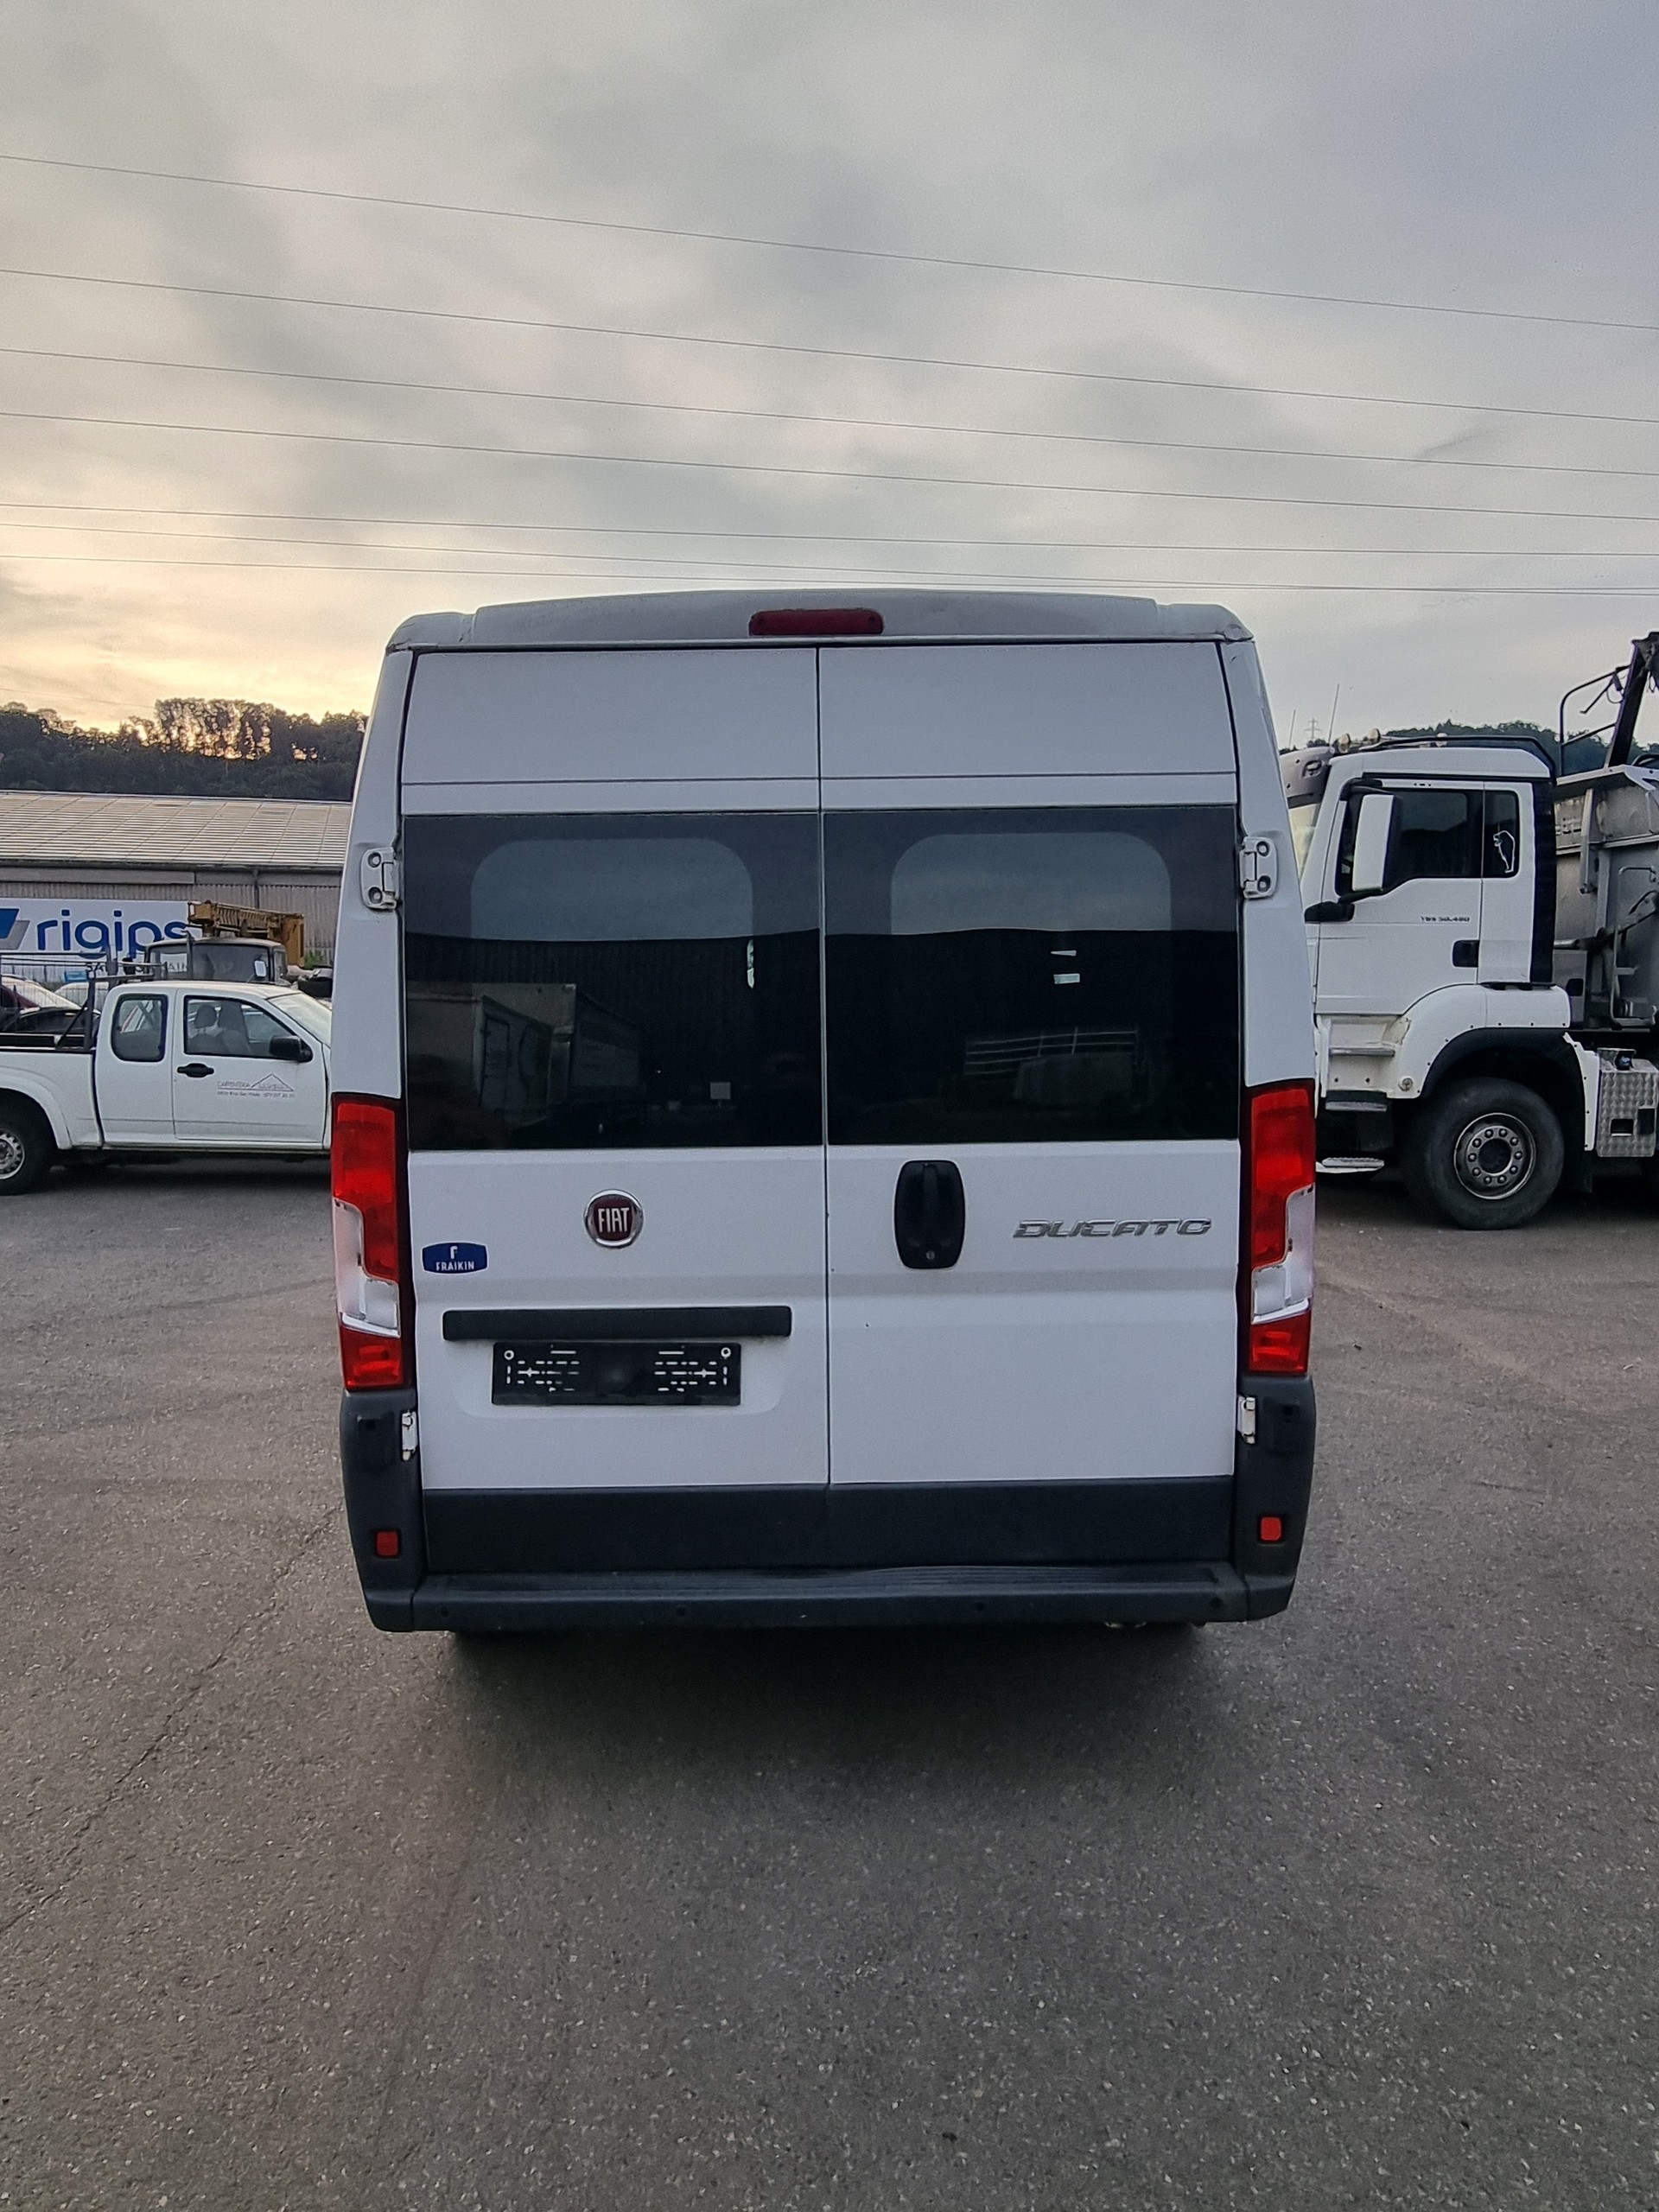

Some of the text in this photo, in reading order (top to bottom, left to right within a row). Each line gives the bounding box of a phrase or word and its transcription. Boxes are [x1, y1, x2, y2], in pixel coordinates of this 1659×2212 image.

[36, 909, 188, 960] rigips
[598, 1207, 630, 1233] FIAT
[1013, 1218, 1212, 1238] DUCATO
[435, 1261, 475, 1272] FRAIKIN
